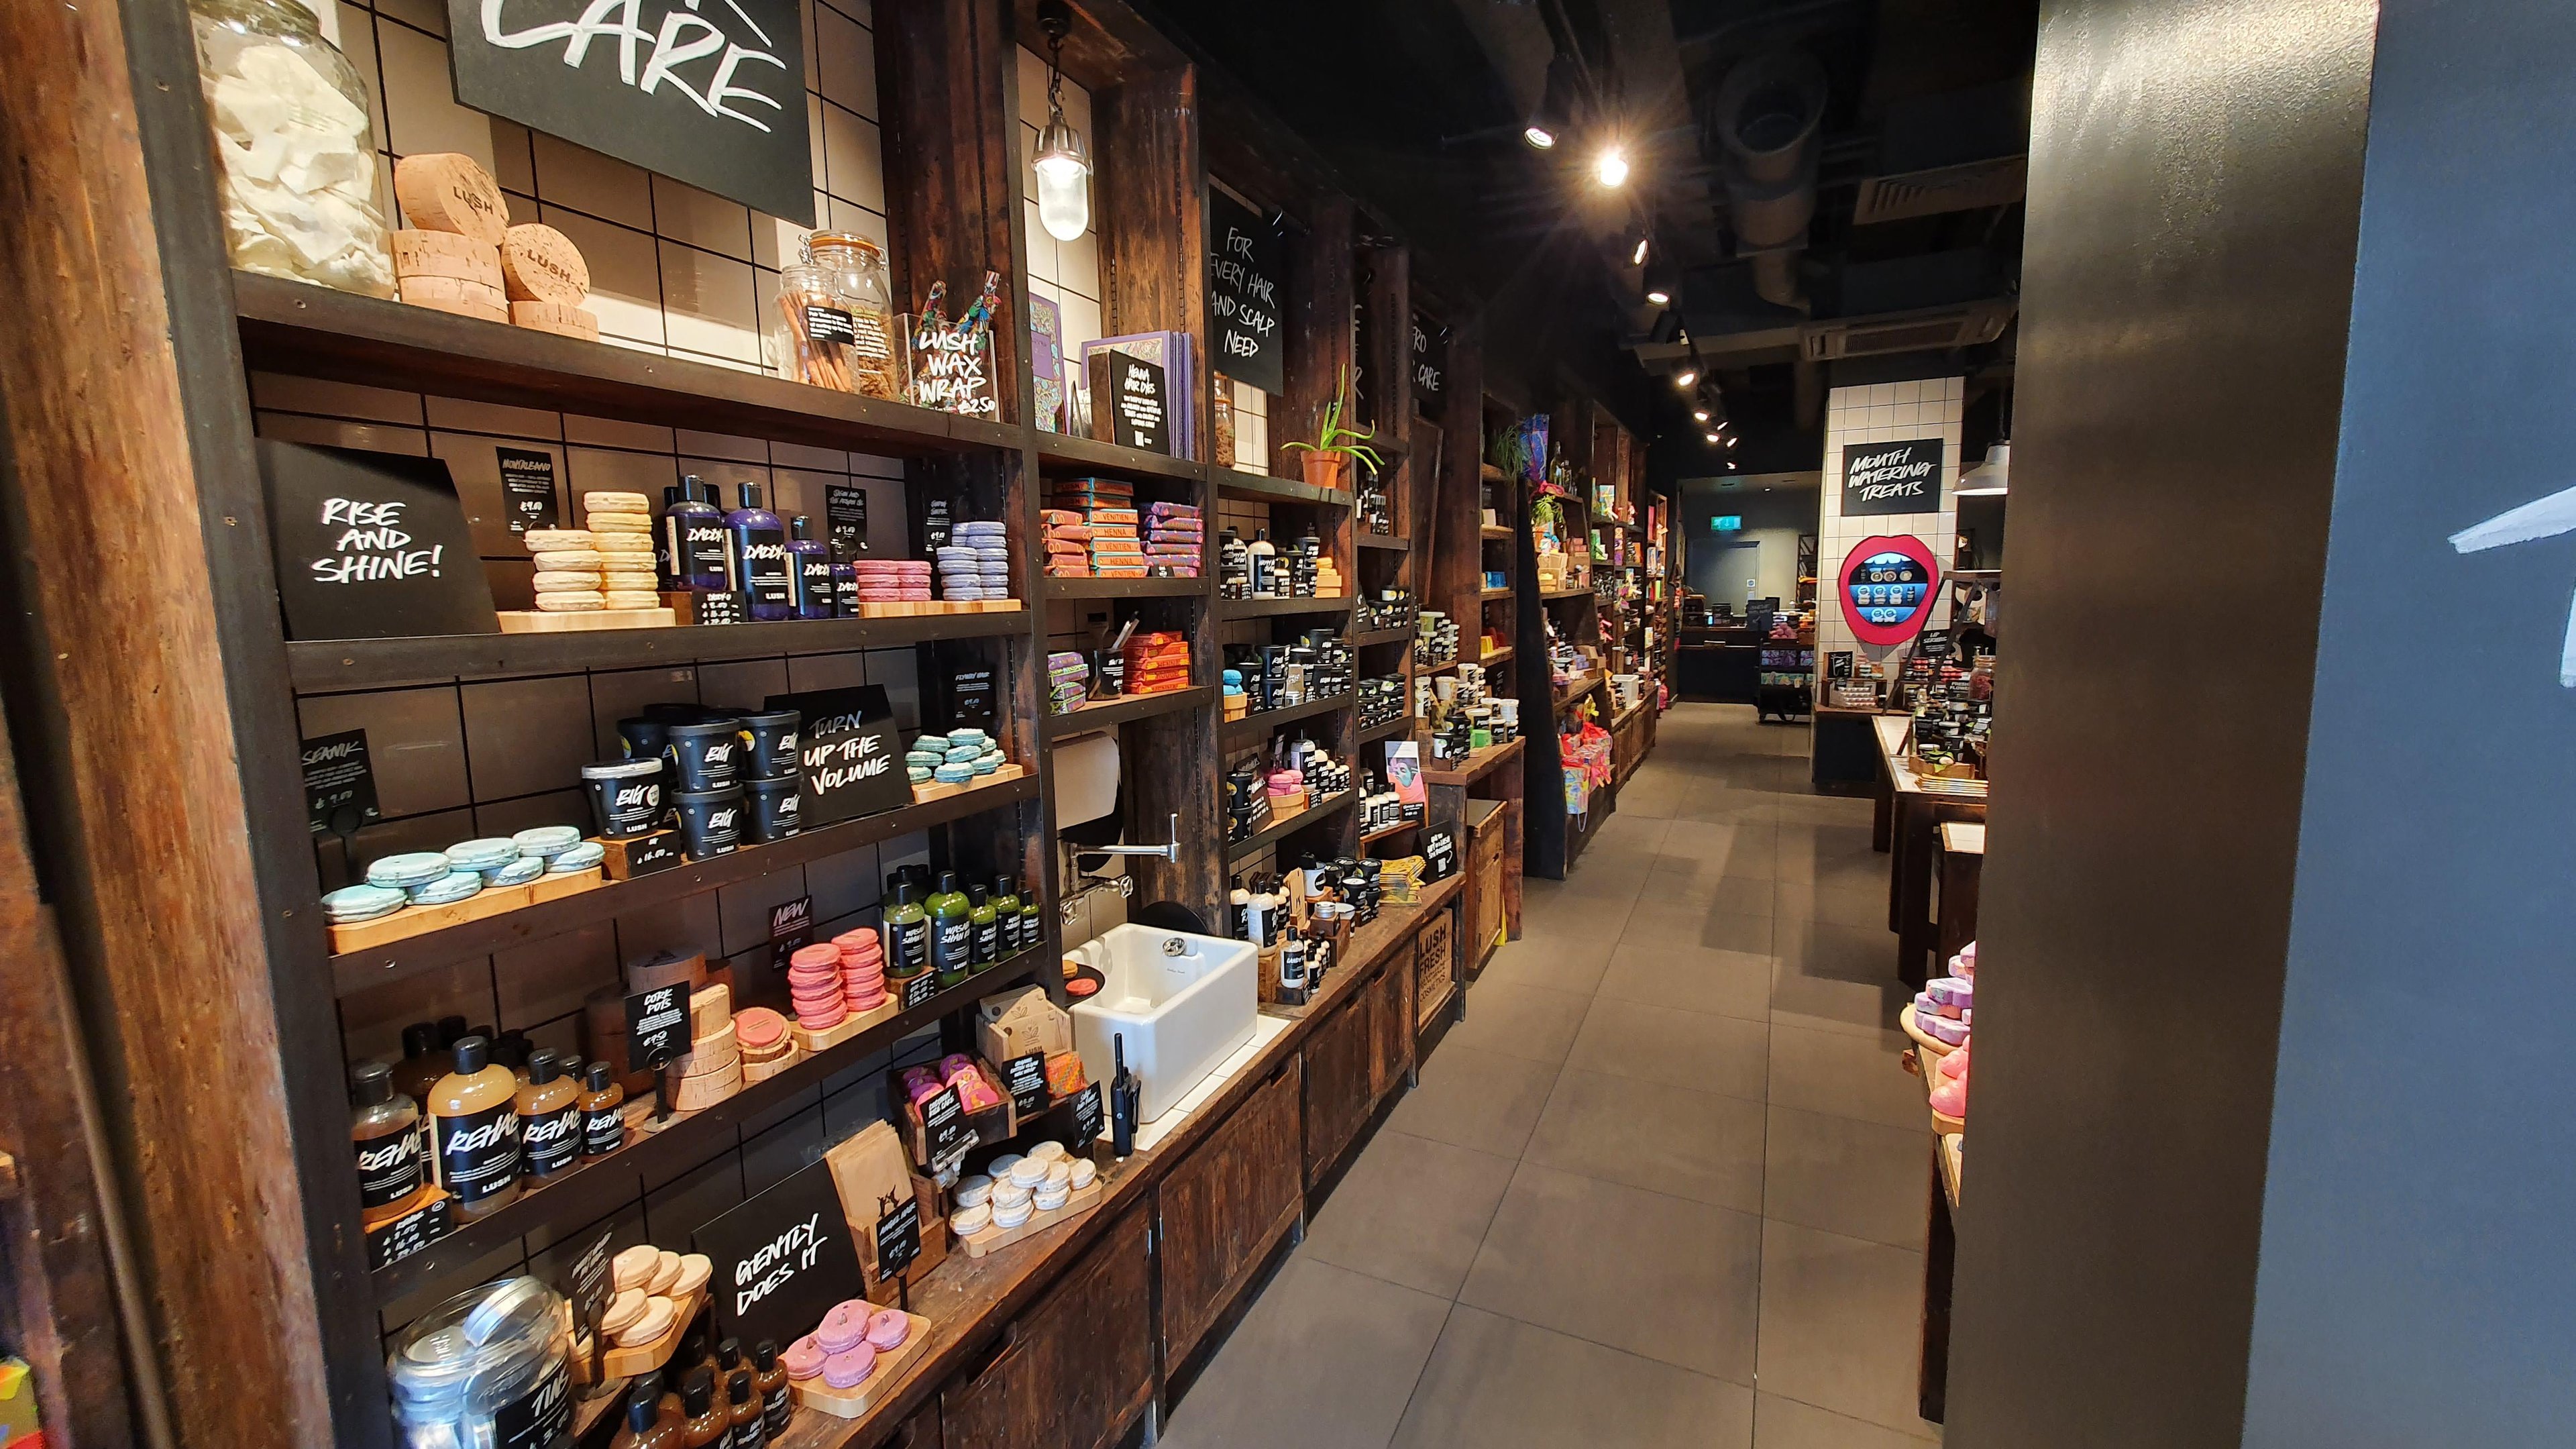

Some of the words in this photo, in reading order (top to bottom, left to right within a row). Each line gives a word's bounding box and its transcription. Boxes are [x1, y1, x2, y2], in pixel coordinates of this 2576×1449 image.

[480, 0, 788, 133] CARE
[453, 186, 494, 217] LUSH
[1227, 226, 1254, 262] FOR
[526, 250, 573, 284] LUSH
[1248, 273, 1275, 309] HAIR
[1211, 290, 1237, 317] AND
[1238, 304, 1275, 337] SCALP
[919, 330, 977, 356] LUSH
[1224, 329, 1259, 358] NEED
[927, 354, 983, 377] WAX
[1128, 364, 1150, 381] HENNA
[1418, 364, 1441, 391] CARE
[919, 376, 987, 402] WRAP
[1124, 377, 1140, 392] HAIR
[1140, 381, 1155, 395] DYES
[1849, 447, 1913, 475] MOUTH
[1847, 463, 1937, 488] WATERING
[1859, 481, 1925, 502] TREATS
[321, 497, 407, 526] RISE
[335, 527, 412, 551] AND
[310, 544, 444, 584] SHINE!
[808, 710, 862, 739] TURN
[704, 743, 734, 763] BIG
[803, 745, 837, 767] UP
[836, 734, 883, 761] THE
[712, 780, 731, 789] LUSH
[810, 754, 892, 796] VOLUME
[616, 785, 649, 806] BIG
[627, 823, 647, 833] LUSH
[708, 808, 737, 829] BIG
[716, 845, 735, 854] LUSH
[773, 898, 809, 927] NEW
[1419, 923, 1446, 958] LUSH
[1419, 942, 1446, 978] FRESH
[644, 989, 673, 1006] CORK
[646, 998, 672, 1015] POTS
[390, 1184, 414, 1199] LUSH
[482, 1174, 511, 1194] LUSH
[879, 1214, 900, 1237] ANGEL
[900, 1201, 916, 1220] HAIR
[735, 1213, 820, 1287] GENTLY
[737, 1261, 795, 1318] DOES
[800, 1236, 827, 1273] IT
[531, 1364, 570, 1417] TINS
